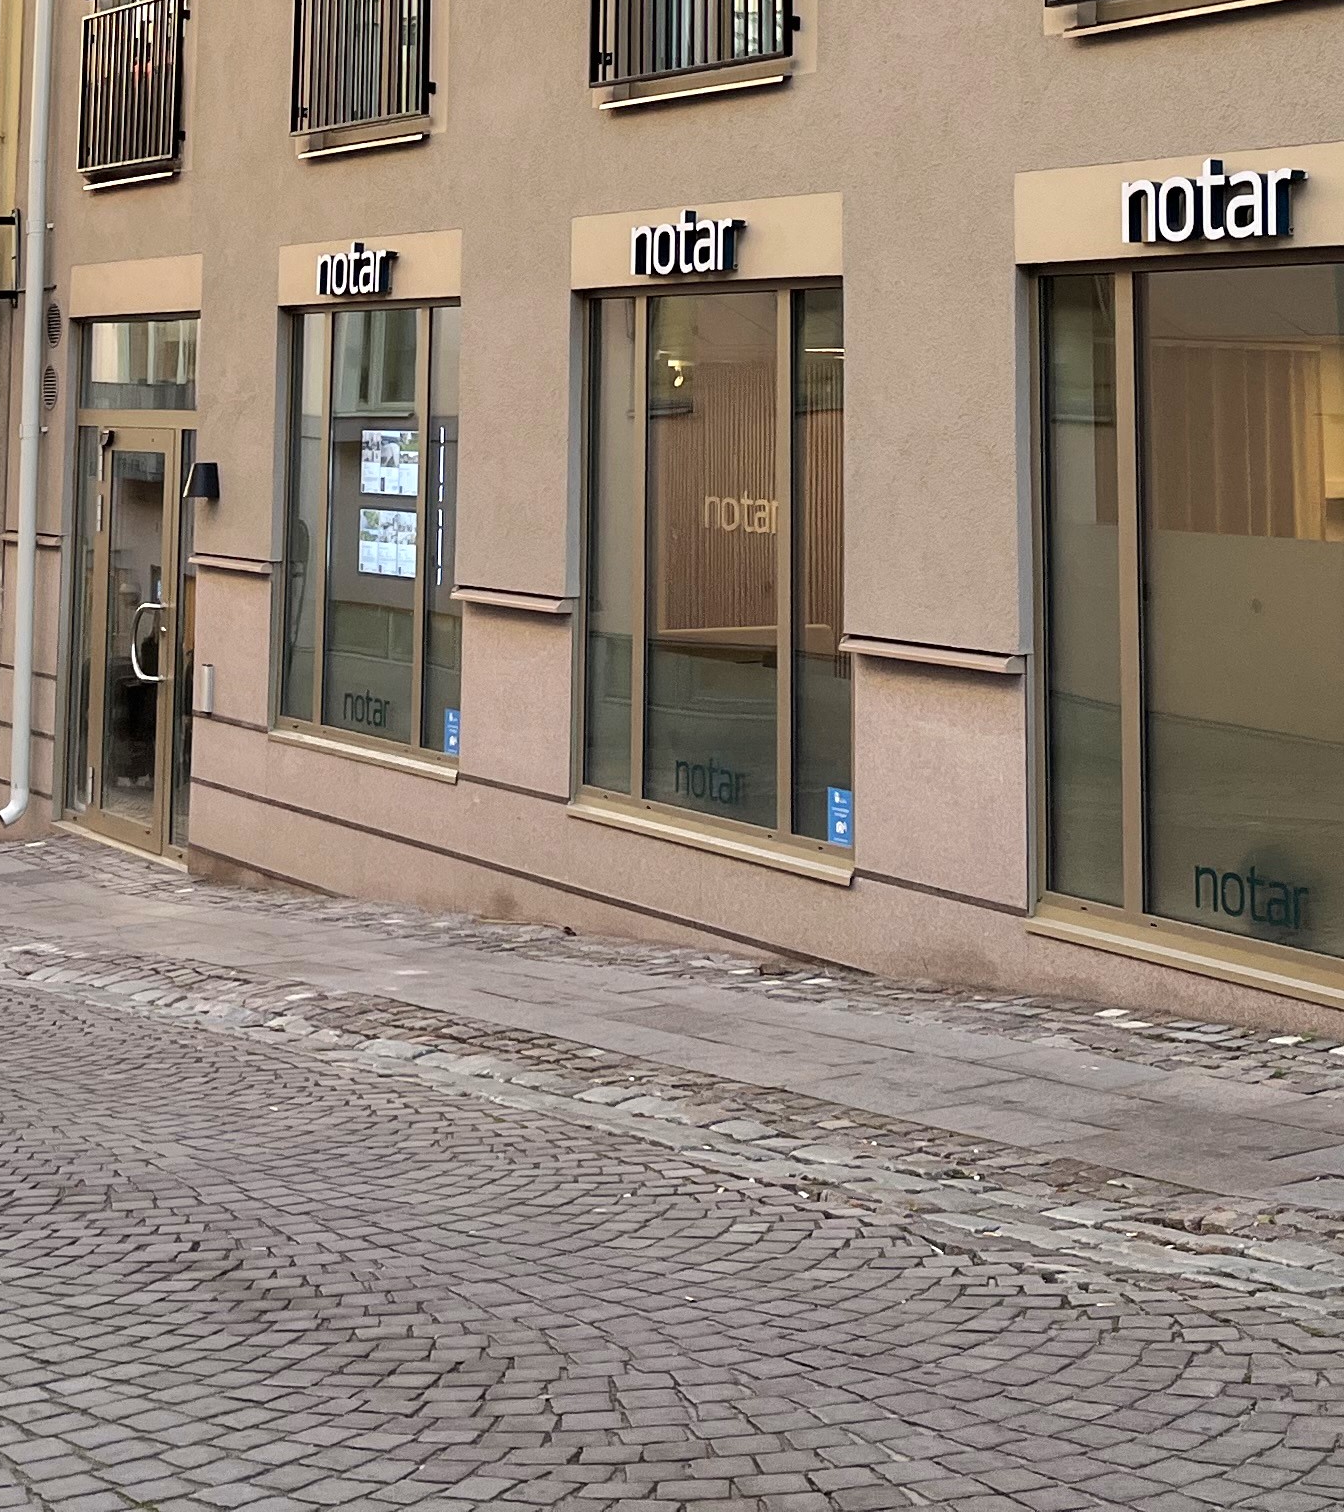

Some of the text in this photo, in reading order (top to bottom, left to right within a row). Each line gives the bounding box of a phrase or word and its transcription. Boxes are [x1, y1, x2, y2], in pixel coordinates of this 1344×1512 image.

[1121, 158, 1307, 243] notar
[316, 241, 397, 295] notar
[630, 209, 747, 275] notar
[704, 490, 779, 535] notar
[343, 688, 390, 727] notar
[675, 758, 747, 804] notar
[1194, 865, 1309, 929] notar
